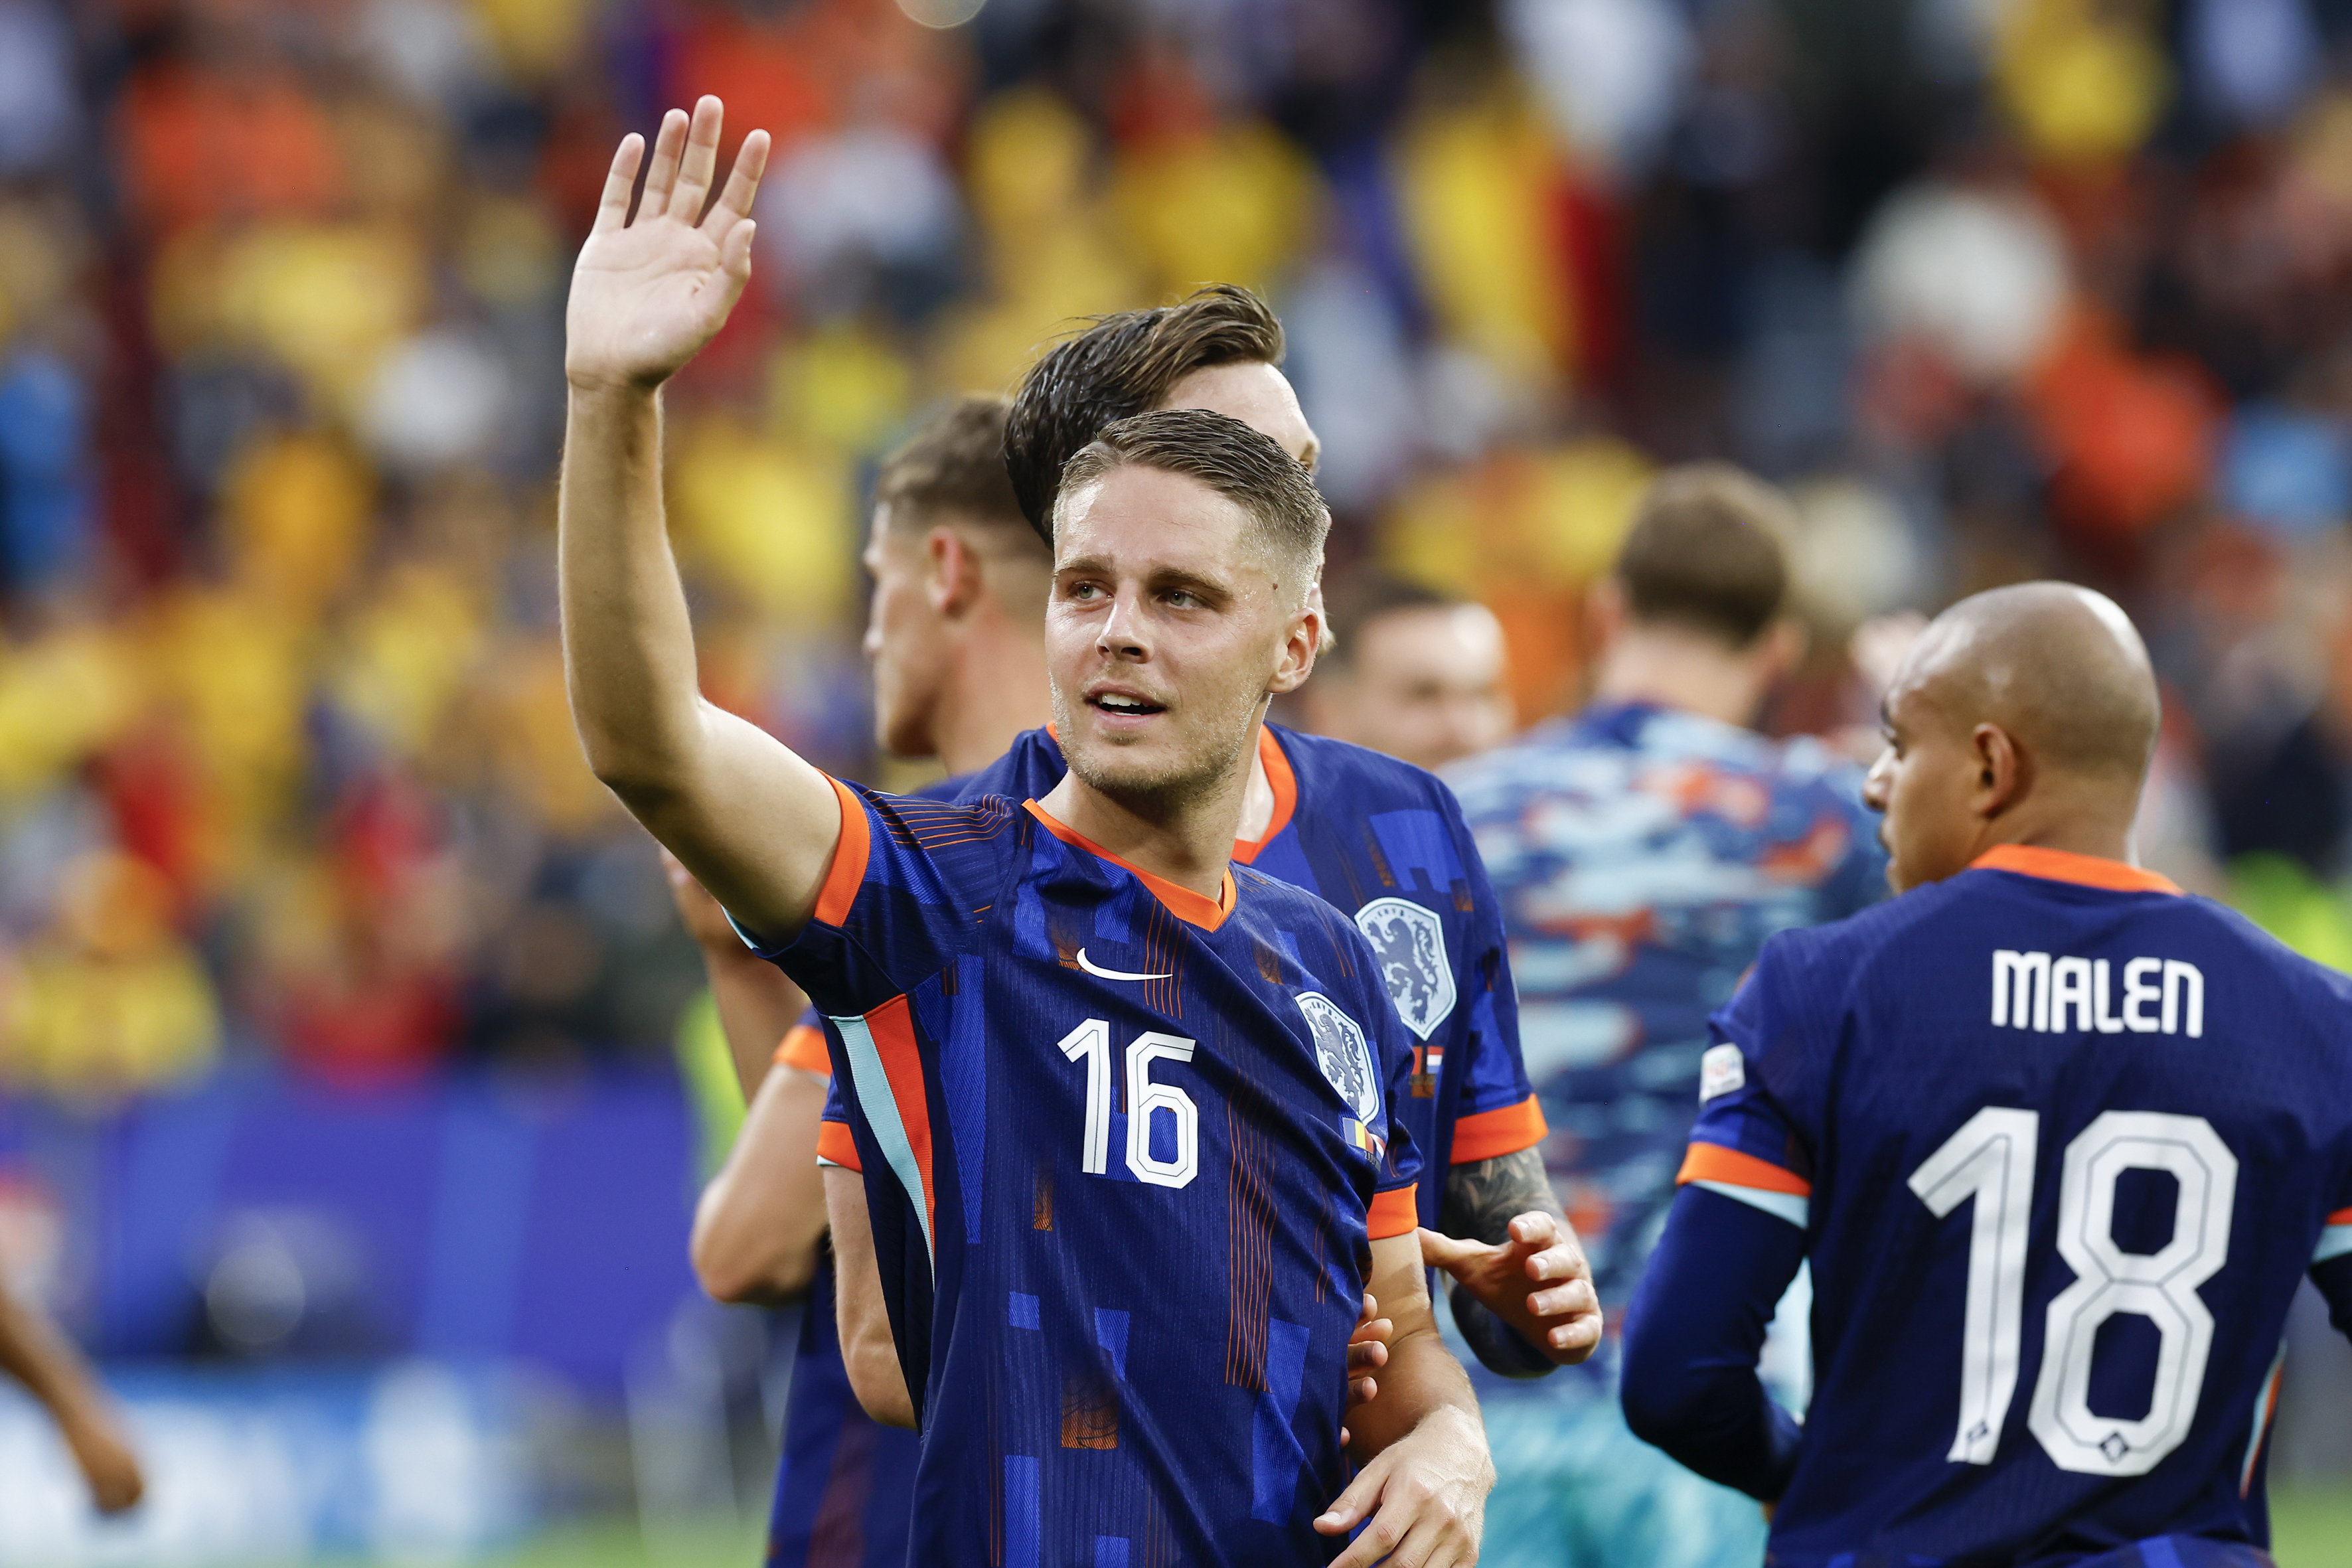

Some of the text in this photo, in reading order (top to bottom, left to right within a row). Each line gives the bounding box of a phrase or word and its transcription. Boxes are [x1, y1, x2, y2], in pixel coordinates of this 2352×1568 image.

[1991, 949, 2204, 1038] MALEN
[1058, 1018, 1198, 1190] 16
[1908, 1105, 2238, 1476] 18
